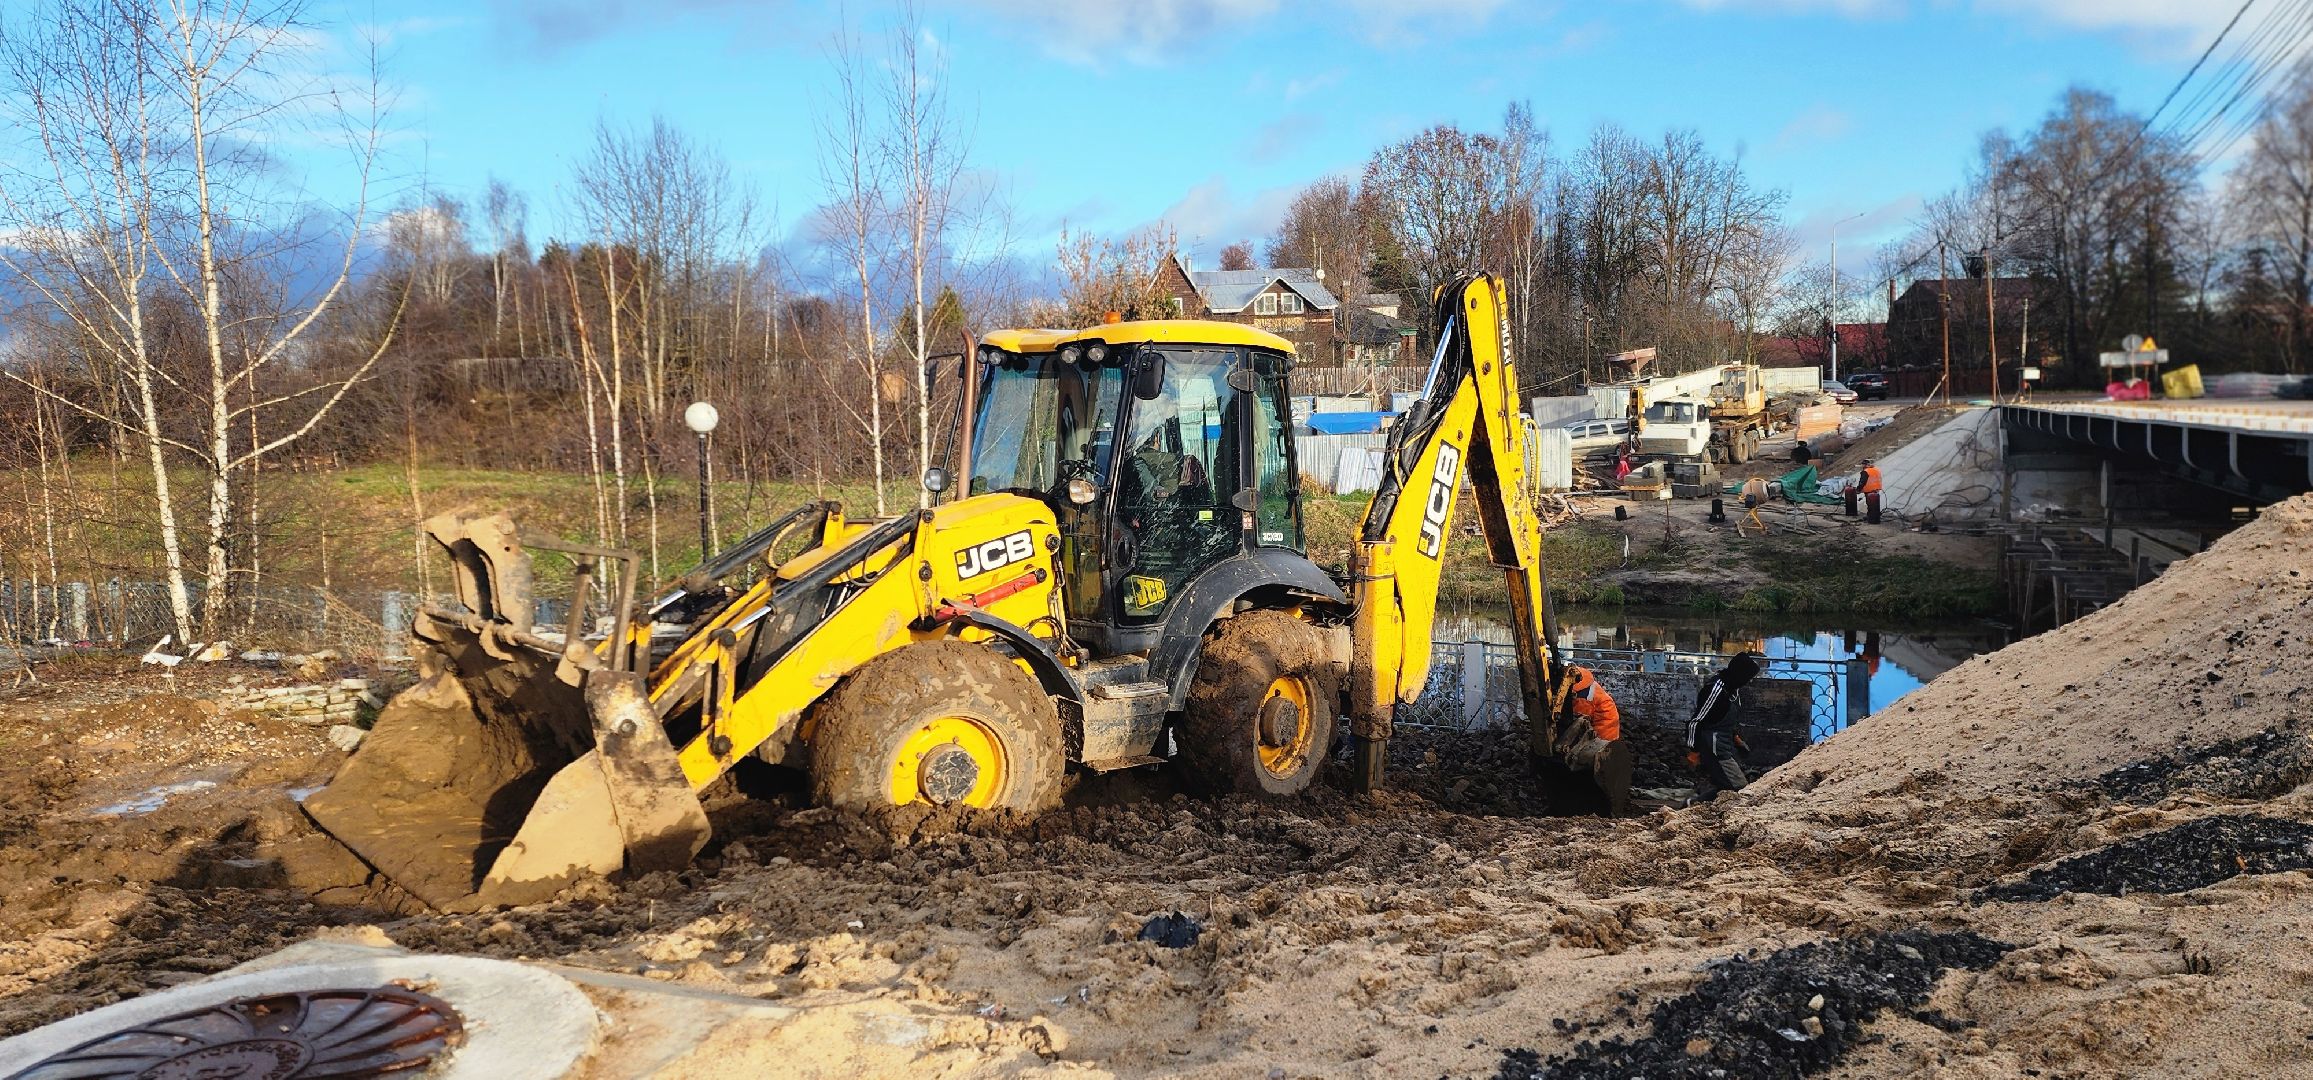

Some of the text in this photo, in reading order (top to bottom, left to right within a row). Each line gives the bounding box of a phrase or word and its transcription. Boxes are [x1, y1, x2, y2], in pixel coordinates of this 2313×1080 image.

[1419, 444, 1459, 557] JCB
[956, 531, 1034, 579] JCB
[1135, 578, 1165, 606] JCB
